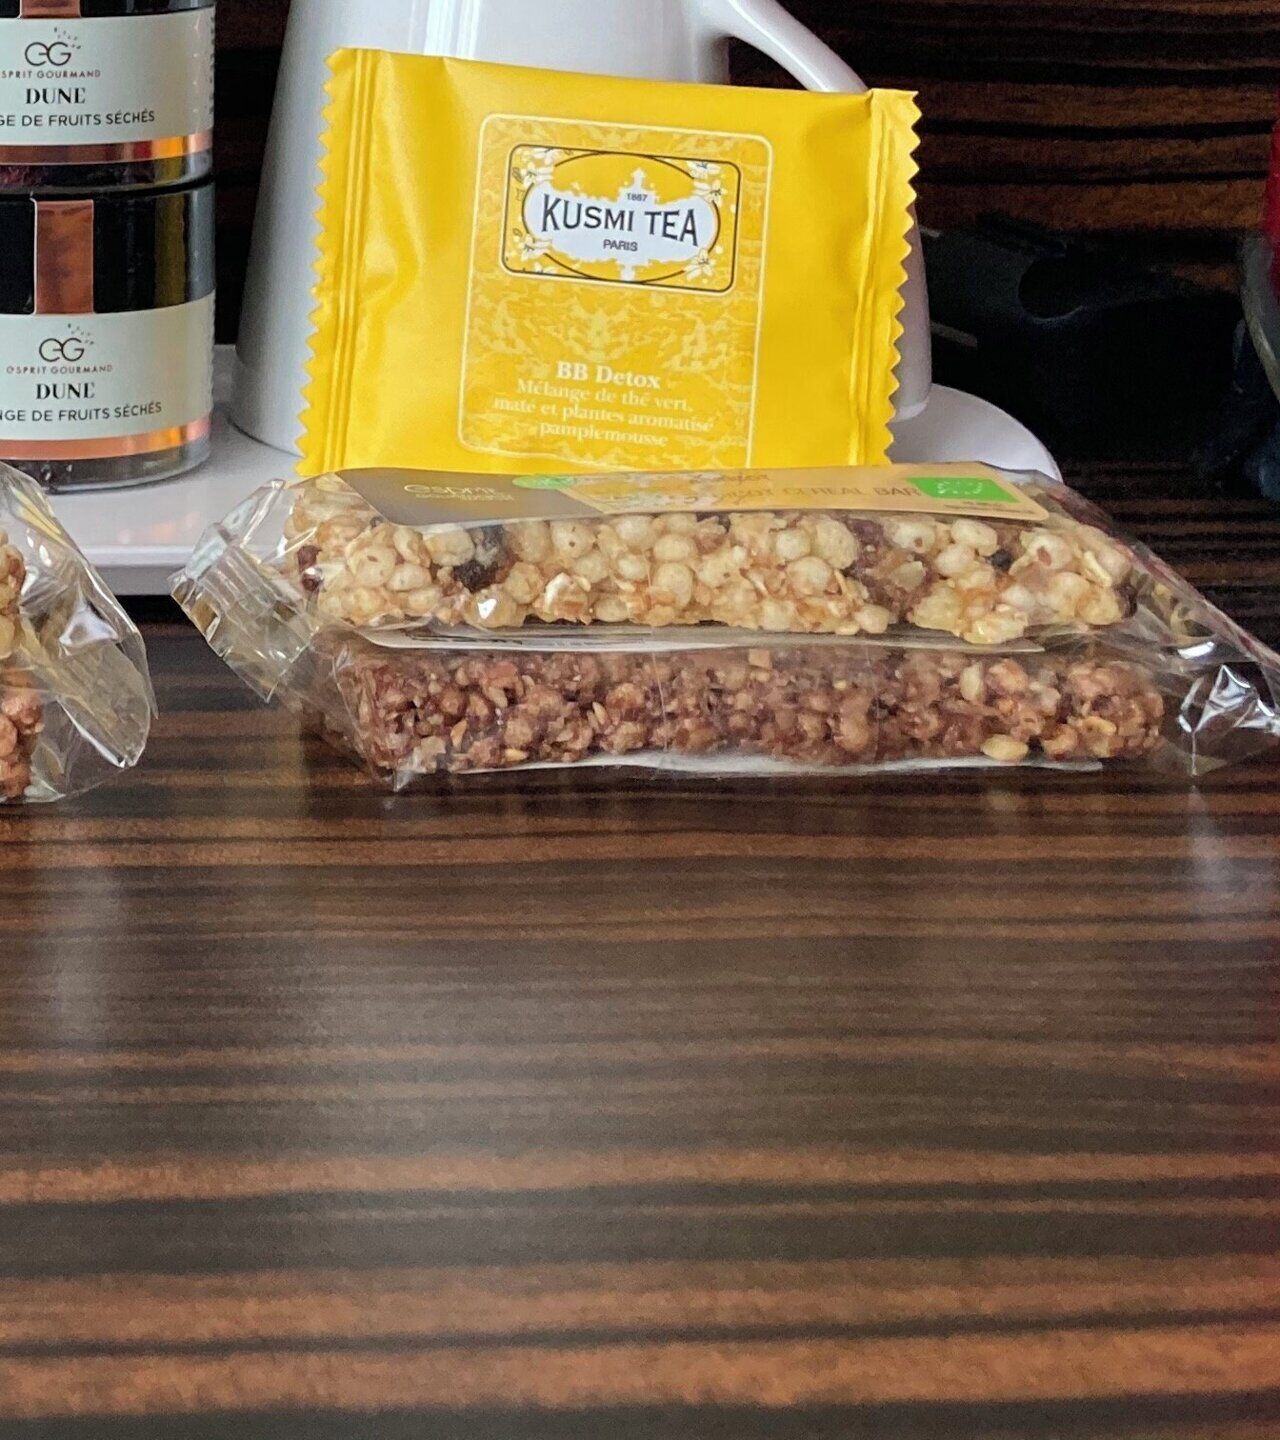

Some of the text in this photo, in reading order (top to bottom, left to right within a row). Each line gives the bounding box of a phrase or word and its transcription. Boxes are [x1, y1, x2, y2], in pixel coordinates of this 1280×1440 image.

[36, 68, 101, 79] GOURMAND
[25, 87, 86, 105] DUNE
[21, 113, 44, 127] DE
[48, 113, 102, 127] FRUITS
[105, 108, 155, 126] SÉCHÉS
[626, 192, 649, 202] 1867
[540, 193, 699, 247] KUSMI TEA
[603, 238, 639, 252] PARIS
[50, 363, 114, 375] GOURMAND
[556, 360, 661, 390] BB Detox
[35, 381, 96, 400] DUNE
[516, 378, 590, 403] Mélange
[595, 386, 617, 404] de
[622, 389, 650, 408] thé
[31, 409, 54, 422] DE
[58, 407, 111, 422] FRUITS
[114, 401, 163, 418] SÉCHÉS
[493, 396, 715, 434] maté et plantes aromatisé
[538, 421, 669, 448] pamplemousse
